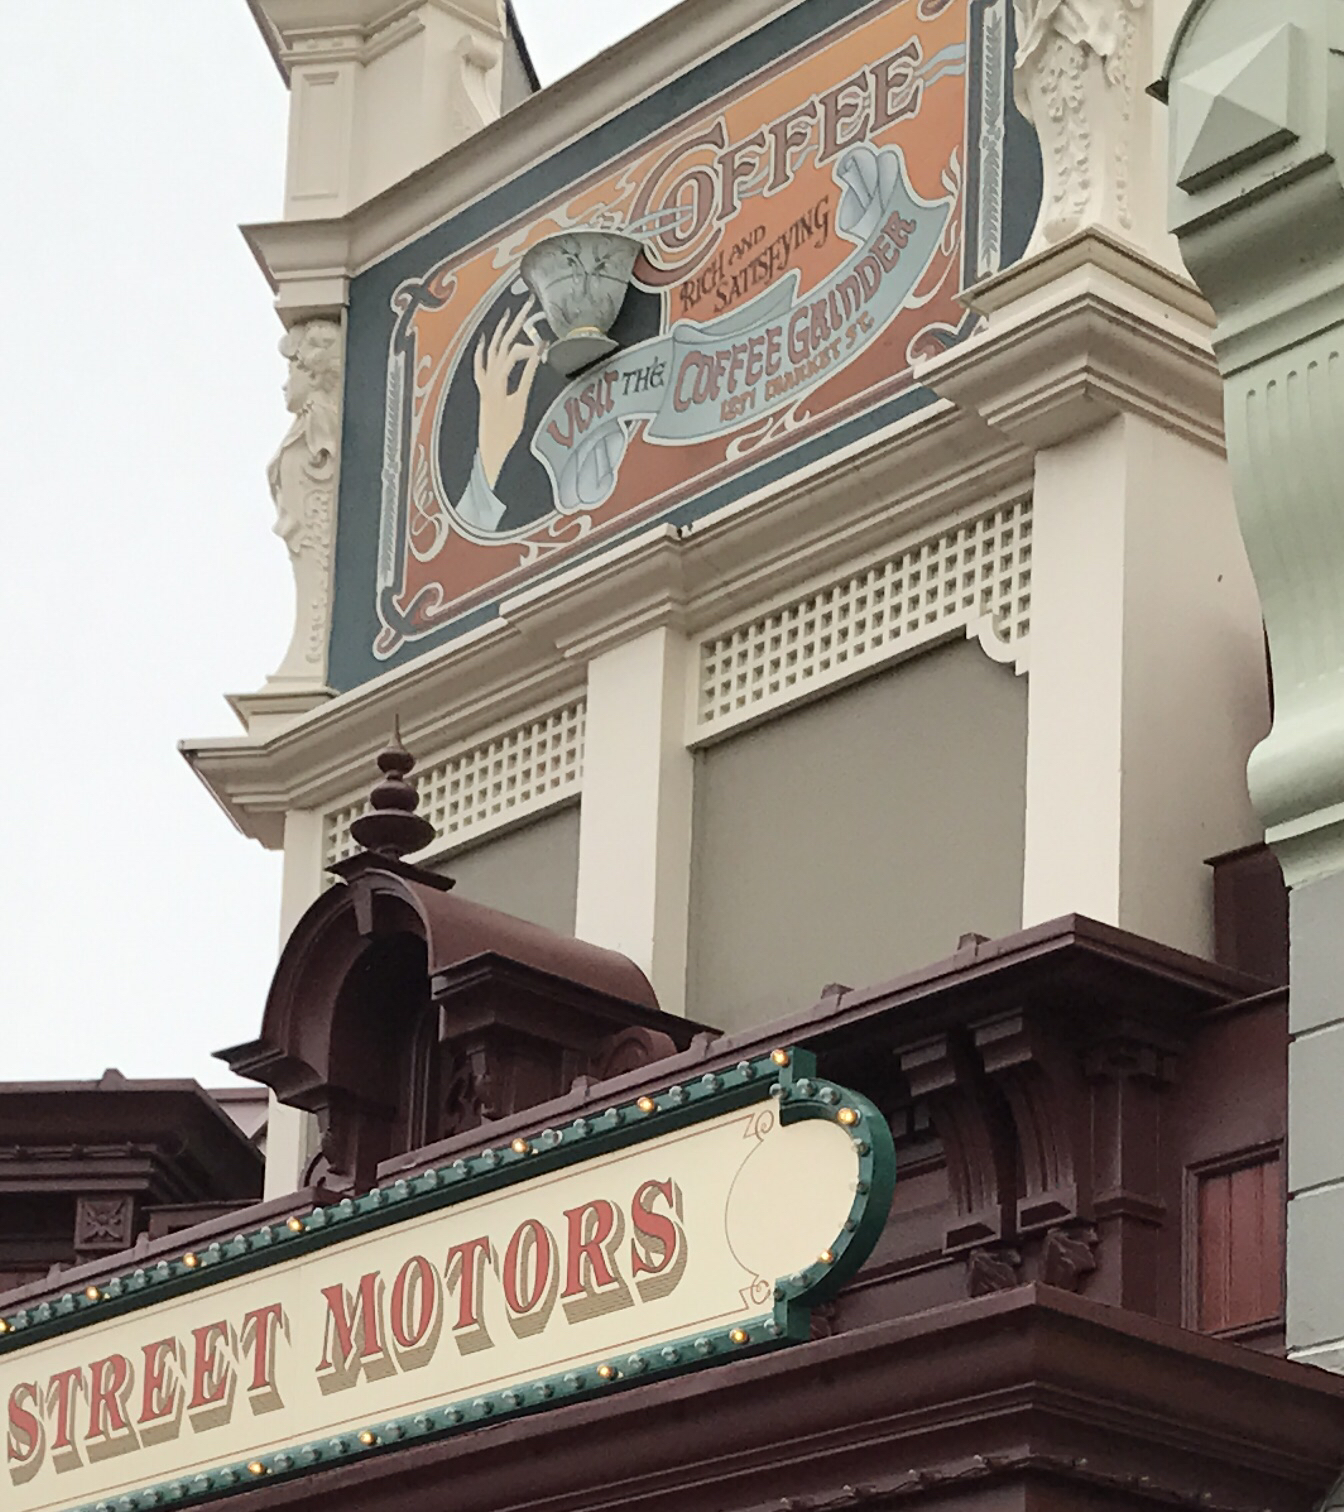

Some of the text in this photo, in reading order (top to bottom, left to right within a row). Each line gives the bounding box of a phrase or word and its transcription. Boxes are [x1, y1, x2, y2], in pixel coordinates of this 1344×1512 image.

[630, 40, 921, 288] COFFEE
[546, 369, 619, 449] VISIT
[673, 326, 783, 413] COFFEE
[788, 210, 917, 365] GRINDER
[679, 225, 767, 313] RICH AND
[713, 195, 832, 313] SATISFYING
[764, 337, 842, 402] MARKET
[6, 1303, 290, 1486] STREET
[315, 1177, 688, 1395] MOTORS
